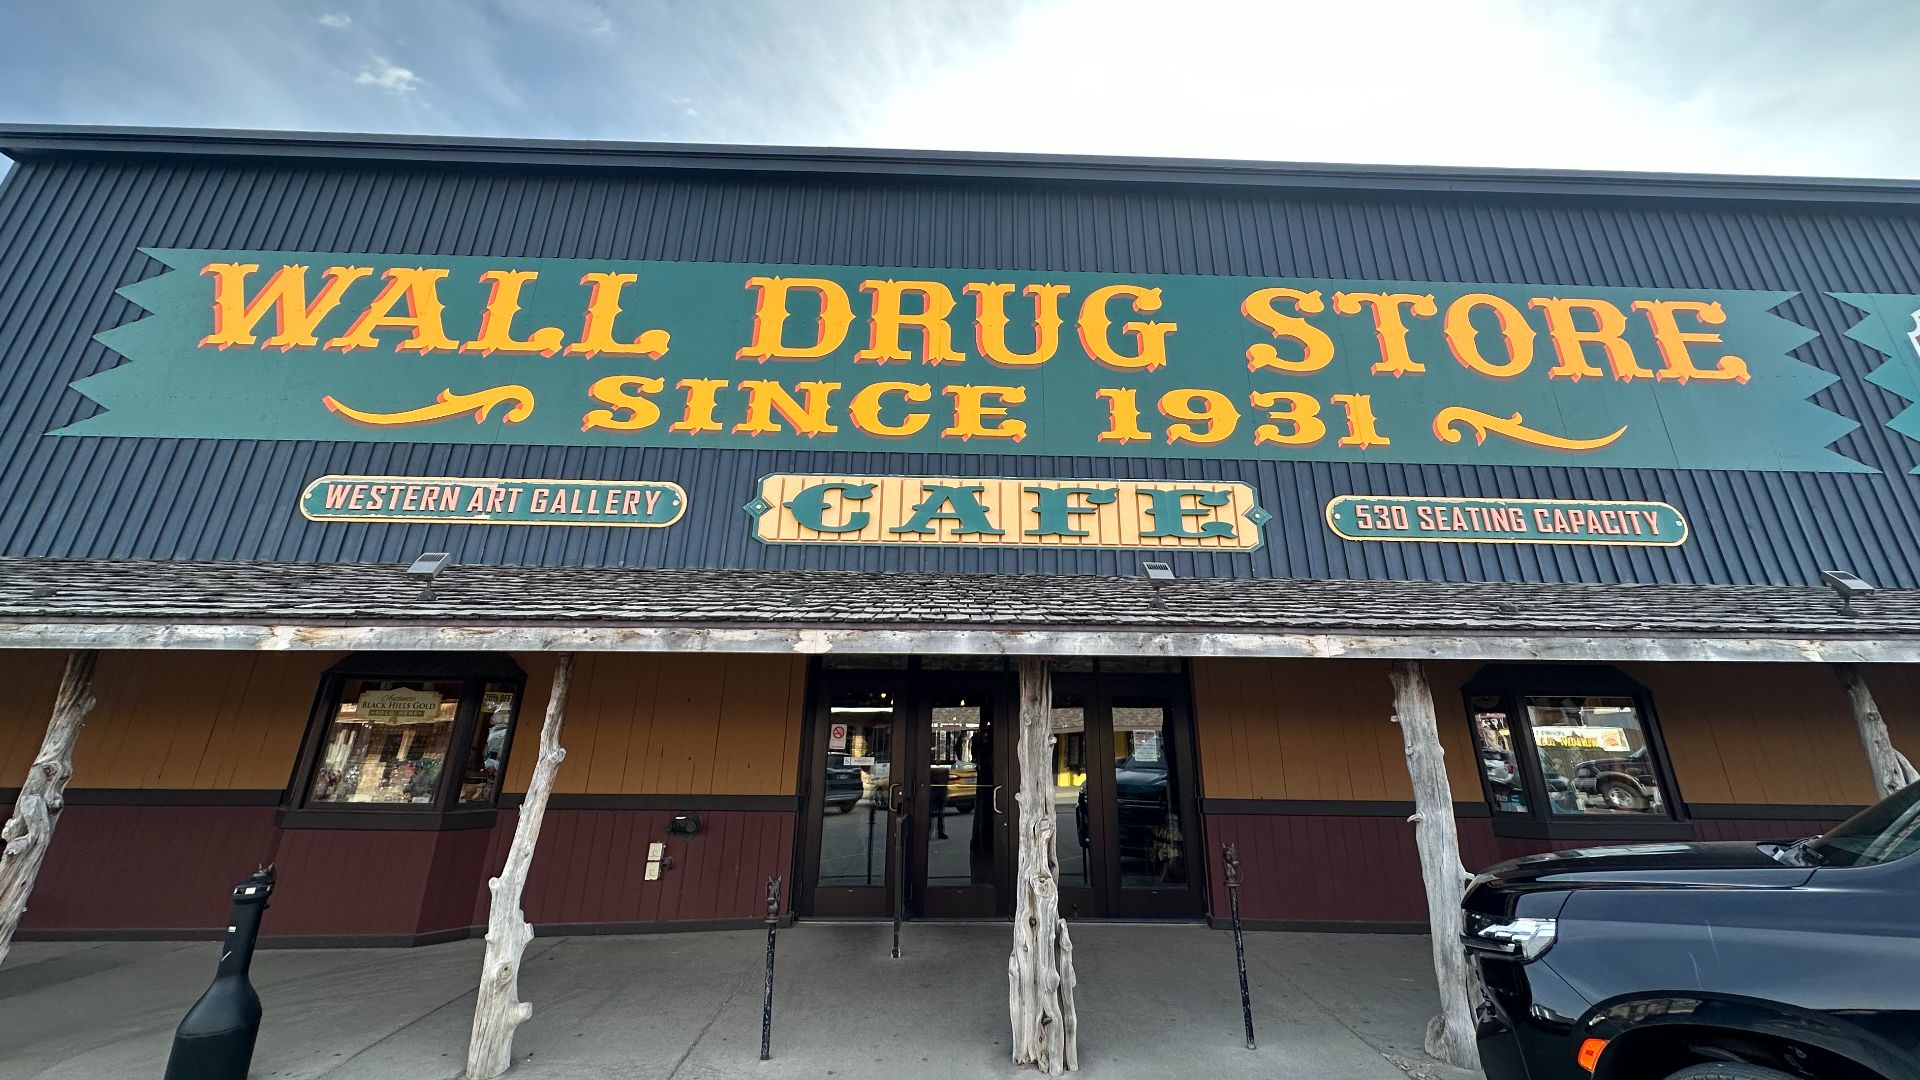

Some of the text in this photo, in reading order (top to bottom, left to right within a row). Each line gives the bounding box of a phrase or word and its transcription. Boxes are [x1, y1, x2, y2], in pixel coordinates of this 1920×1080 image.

[198, 261, 1751, 385] WALL DRUG STORE
[581, 375, 1391, 449] SINCE 1931
[325, 484, 661, 515] WESTERN ART GALLERY
[782, 482, 1239, 540] CAFE
[1355, 504, 1660, 536] 530 SEATING CAPACITY
[361, 701, 387, 709] BLACK
[412, 702, 436, 710] GOLD
